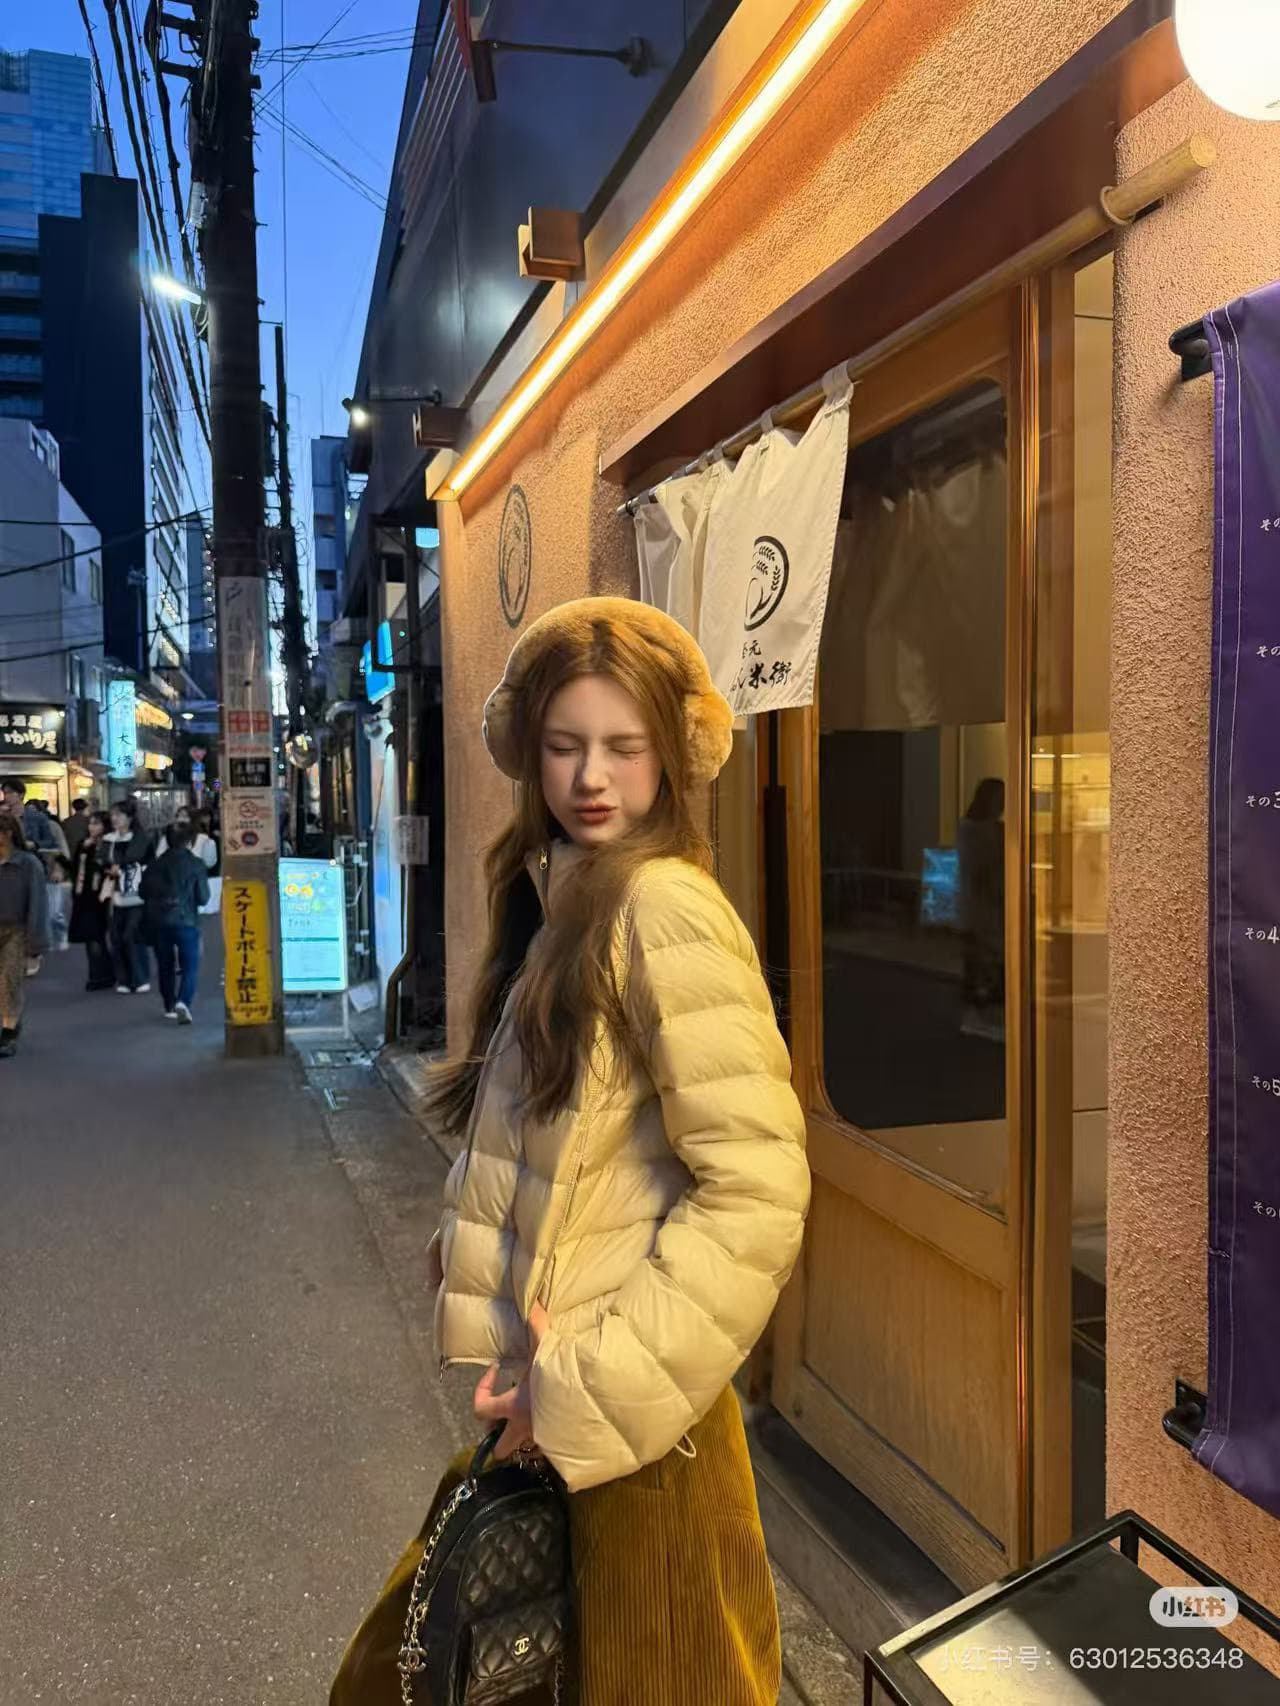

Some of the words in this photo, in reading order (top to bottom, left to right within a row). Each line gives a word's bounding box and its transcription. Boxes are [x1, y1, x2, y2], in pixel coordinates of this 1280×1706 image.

[1245, 925, 1280, 944] その4
[1252, 1075, 1280, 1096] その5
[1253, 1200, 1280, 1218] その
